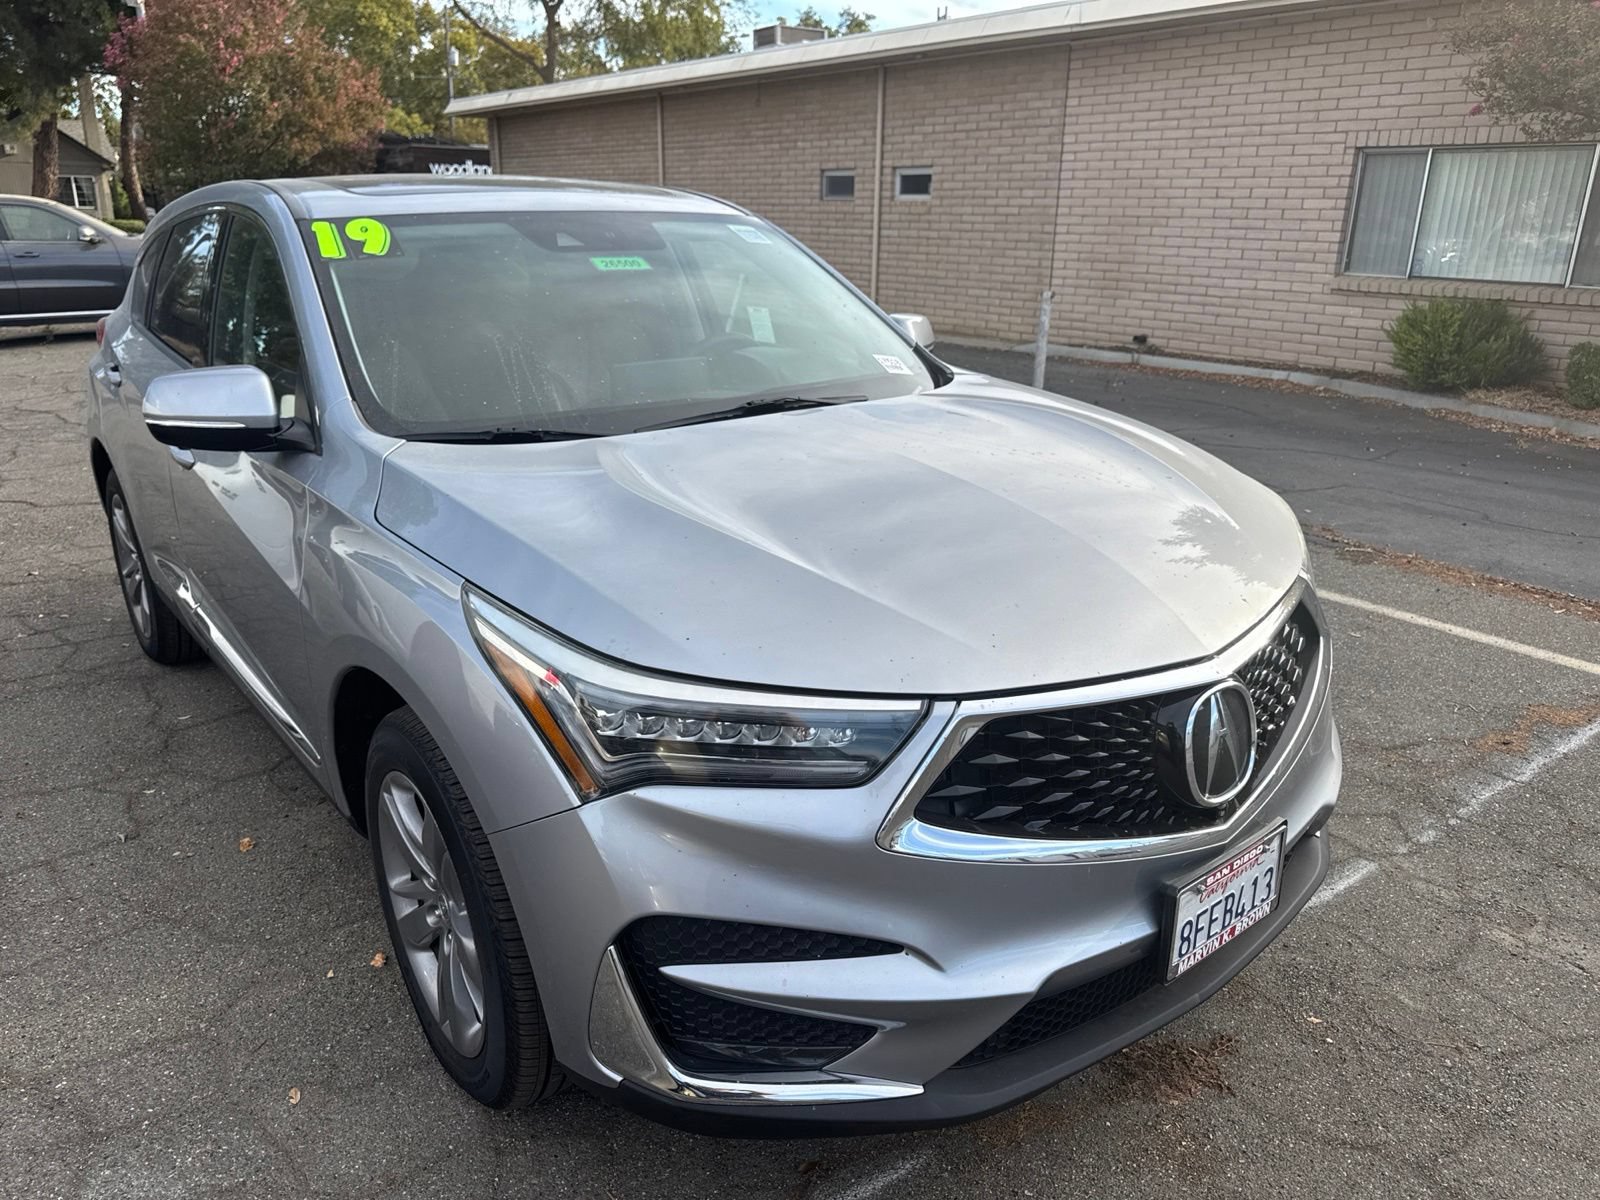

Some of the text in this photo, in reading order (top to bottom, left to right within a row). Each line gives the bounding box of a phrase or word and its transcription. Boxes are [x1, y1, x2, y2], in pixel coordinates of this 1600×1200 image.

[311, 218, 391, 258] 19
[1206, 845, 1264, 885] SAN DIEGO
[1176, 938, 1220, 975] MARVIN
[1235, 903, 1272, 934] BROWN
[1178, 867, 1274, 958] 8FEB413
